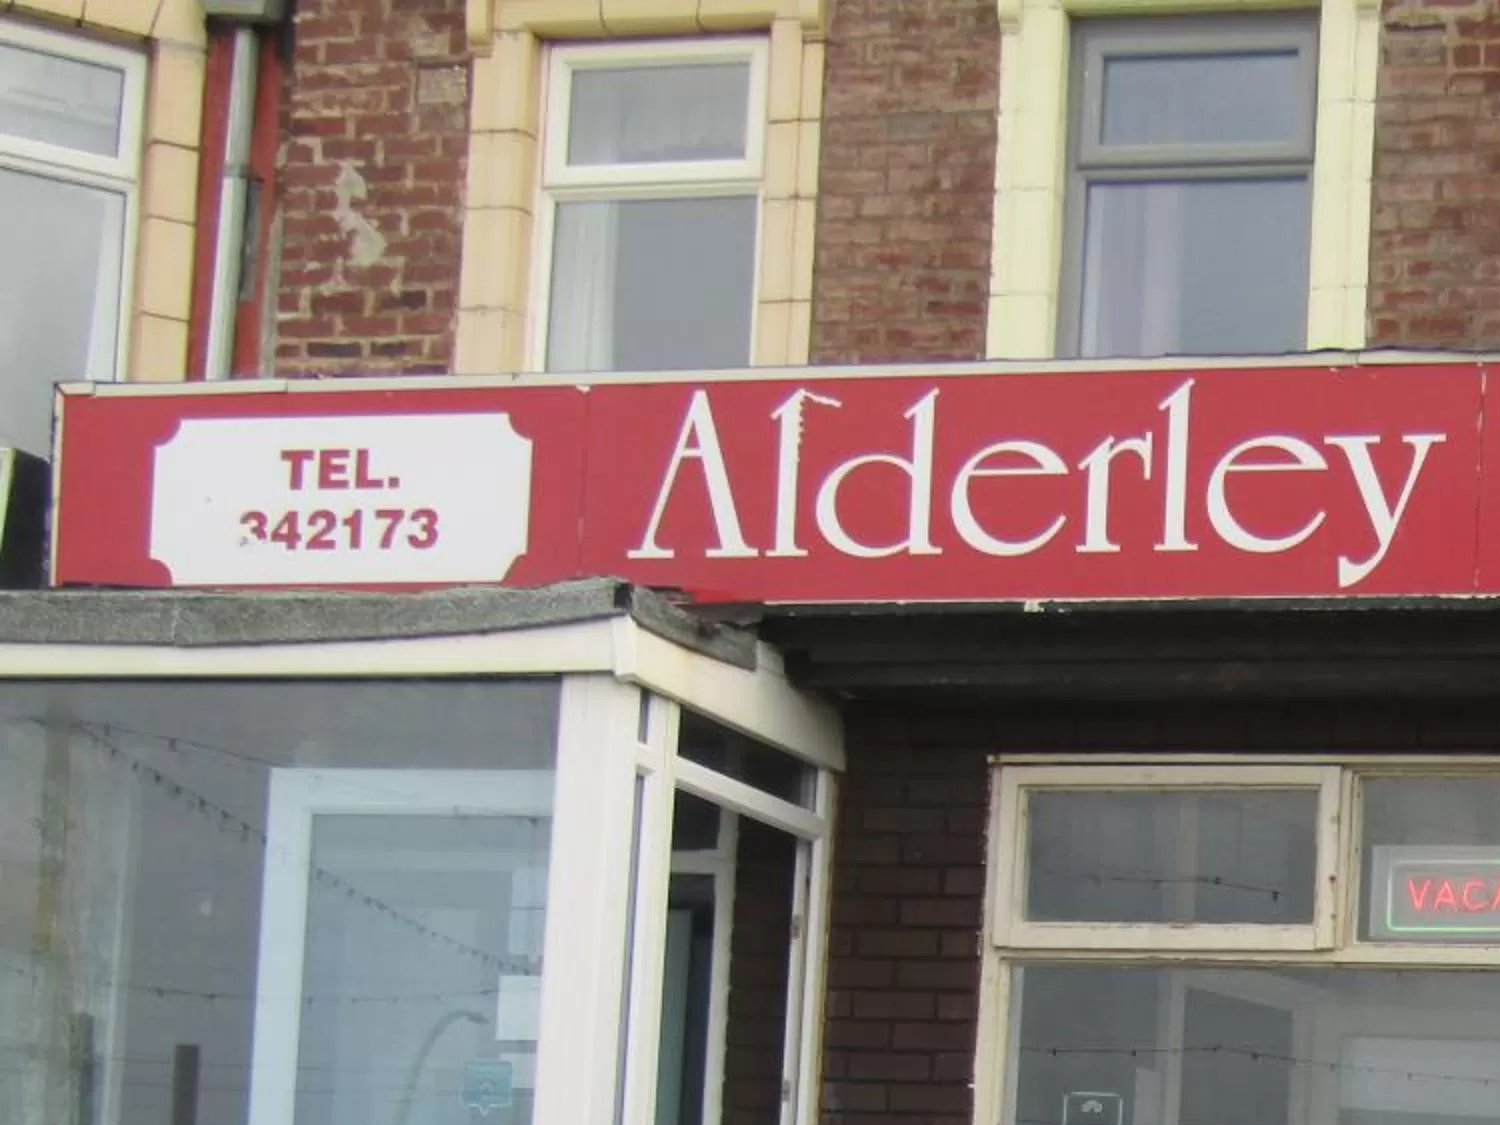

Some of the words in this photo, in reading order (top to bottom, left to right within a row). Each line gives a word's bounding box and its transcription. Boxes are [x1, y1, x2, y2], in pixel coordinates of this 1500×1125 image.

[280, 448, 400, 490] TEL.
[627, 378, 1446, 589] Alderley
[239, 508, 440, 550] 342173
